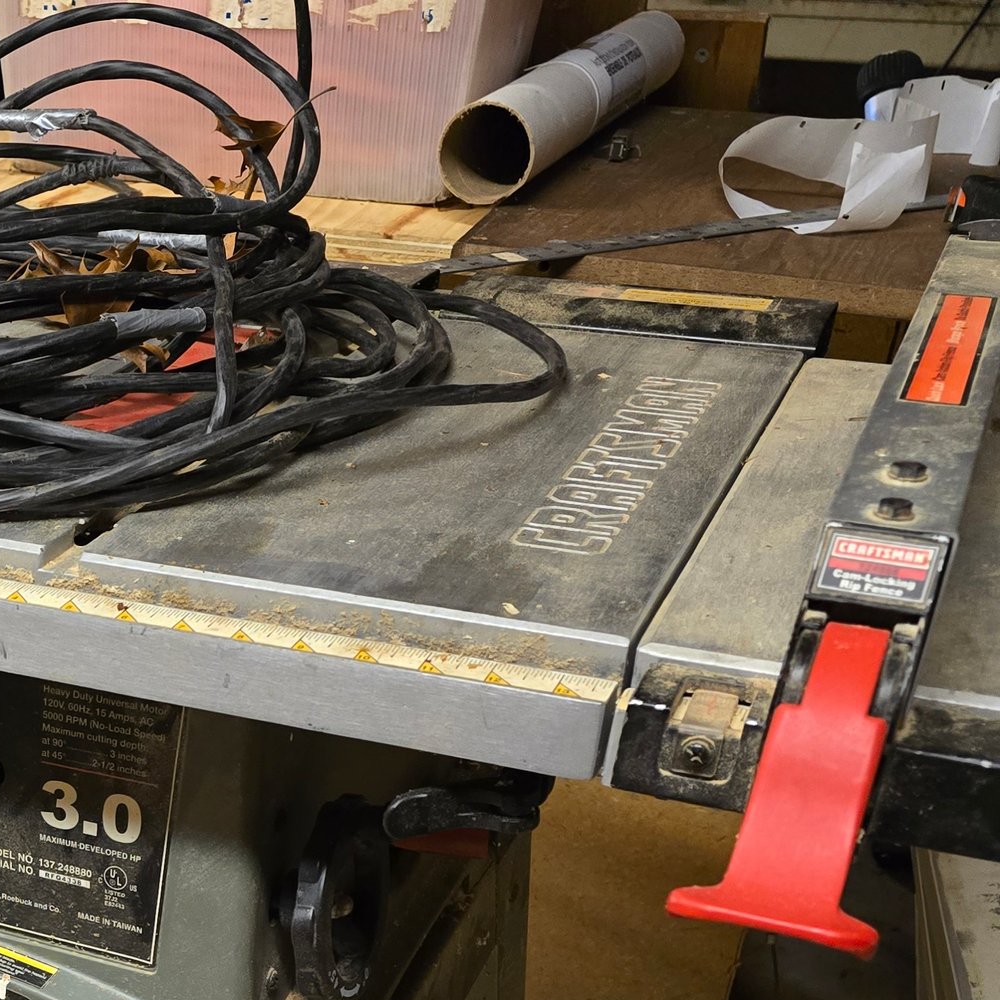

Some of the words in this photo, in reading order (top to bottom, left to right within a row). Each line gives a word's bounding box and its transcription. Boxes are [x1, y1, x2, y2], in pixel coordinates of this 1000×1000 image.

[510, 376, 723, 556] CRAFTSMAN
[839, 542, 925, 564] CRAFTSMAN
[832, 568, 916, 592] Cam-Locking
[839, 579, 861, 593] Rip
[863, 583, 903, 597] Fence
[43, 685, 71, 699] Heavy
[73, 690, 94, 703] Duty
[96, 695, 138, 710] Universal
[140, 703, 168, 715] Motor
[42, 711, 64, 722] 5000
[65, 715, 88, 726] RPM
[89, 720, 131, 736] (No-Load
[134, 728, 166, 743] Speed)
[96, 708, 107, 717] 15
[140, 717, 154, 727] AC
[42, 723, 85, 739] Maximum
[87, 733, 118, 747] cutting
[120, 739, 146, 752] depth
[42, 737, 50, 745] at
[118, 750, 147, 765] inches
[117, 764, 146, 778] inches
[41, 780, 142, 844] 3.0
[39, 833, 78, 848] MAXIMUM
[79, 843, 128, 860] DEVELOPED
[129, 854, 142, 863] HP
[18, 852, 35, 865] NO.
[38, 858, 92, 878] 137.248880
[18, 864, 36, 876] NO.
[104, 889, 126, 898] LISTED
[129, 884, 138, 892] US
[34, 902, 48, 911] and
[49, 905, 61, 914] Co.
[77, 912, 100, 923] MADE
[102, 918, 111, 926] IN
[112, 920, 143, 934] TAIWAN
